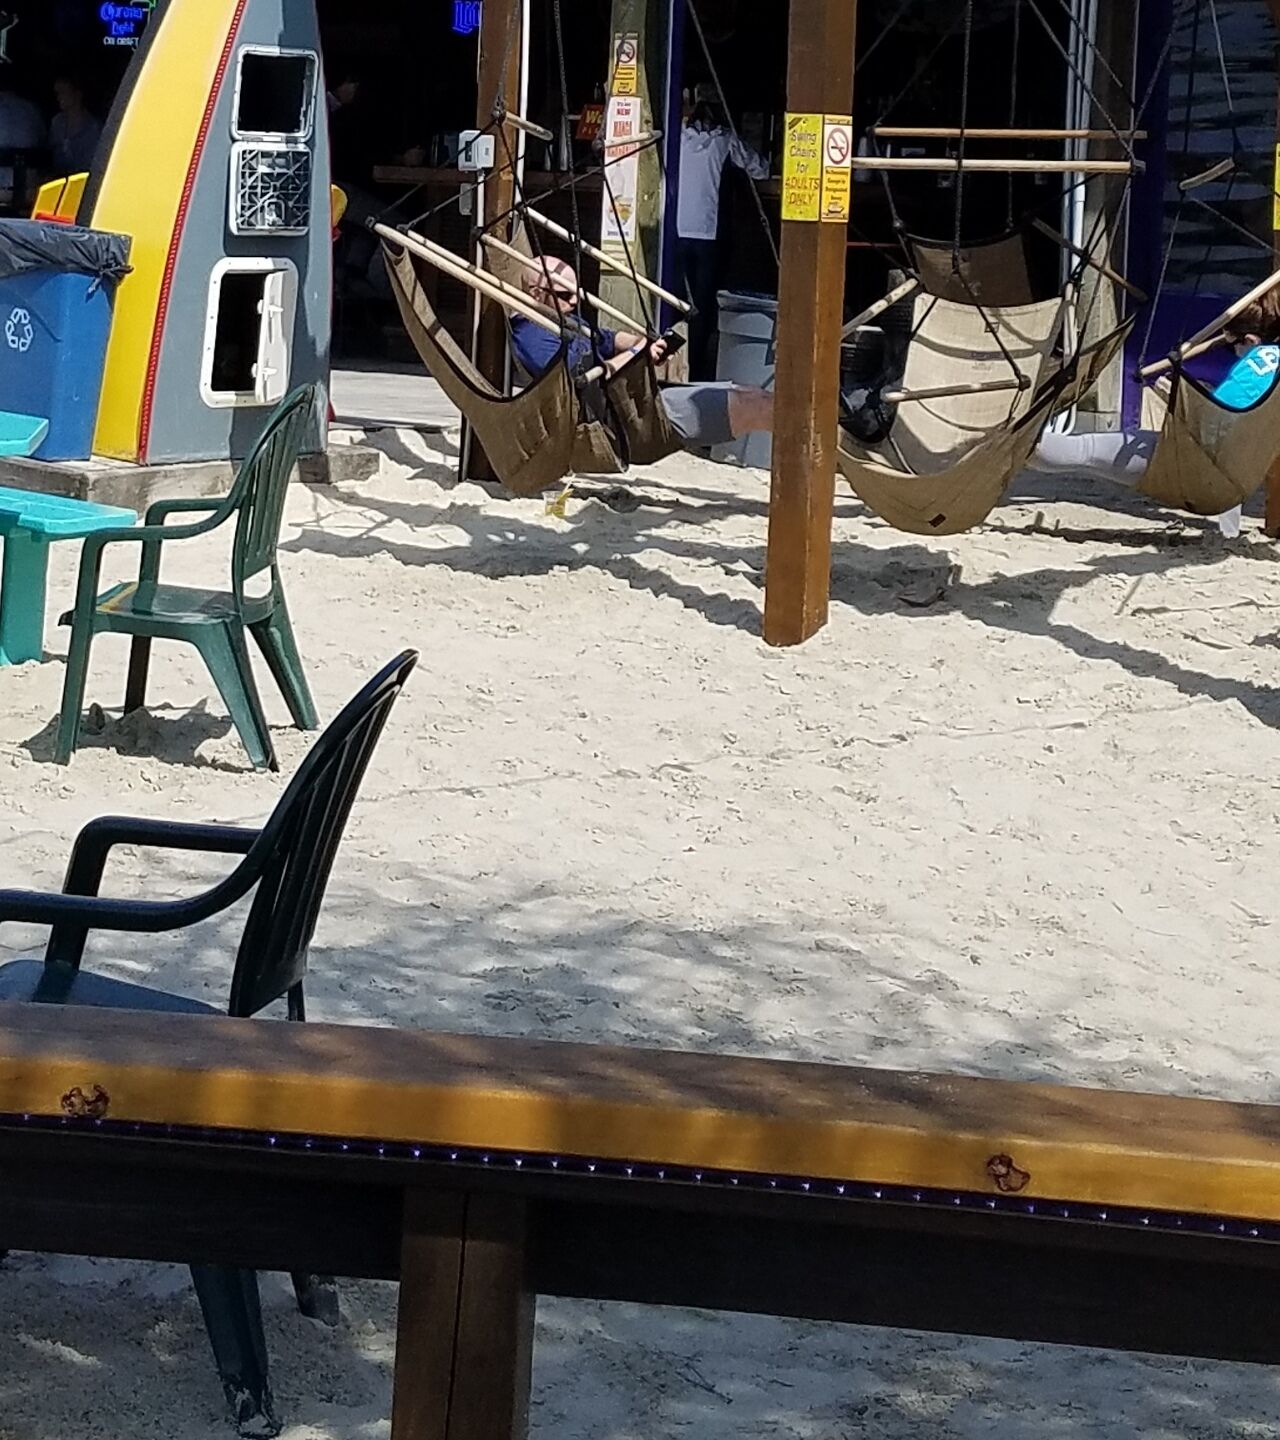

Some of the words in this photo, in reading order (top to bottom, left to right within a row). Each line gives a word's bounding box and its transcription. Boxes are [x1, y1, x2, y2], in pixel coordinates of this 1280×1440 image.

[790, 130, 817, 145] Swing
[790, 145, 817, 158] Chairs
[796, 161, 809, 173] for
[785, 177, 820, 190] ADULTS
[788, 192, 815, 206] ONLY
